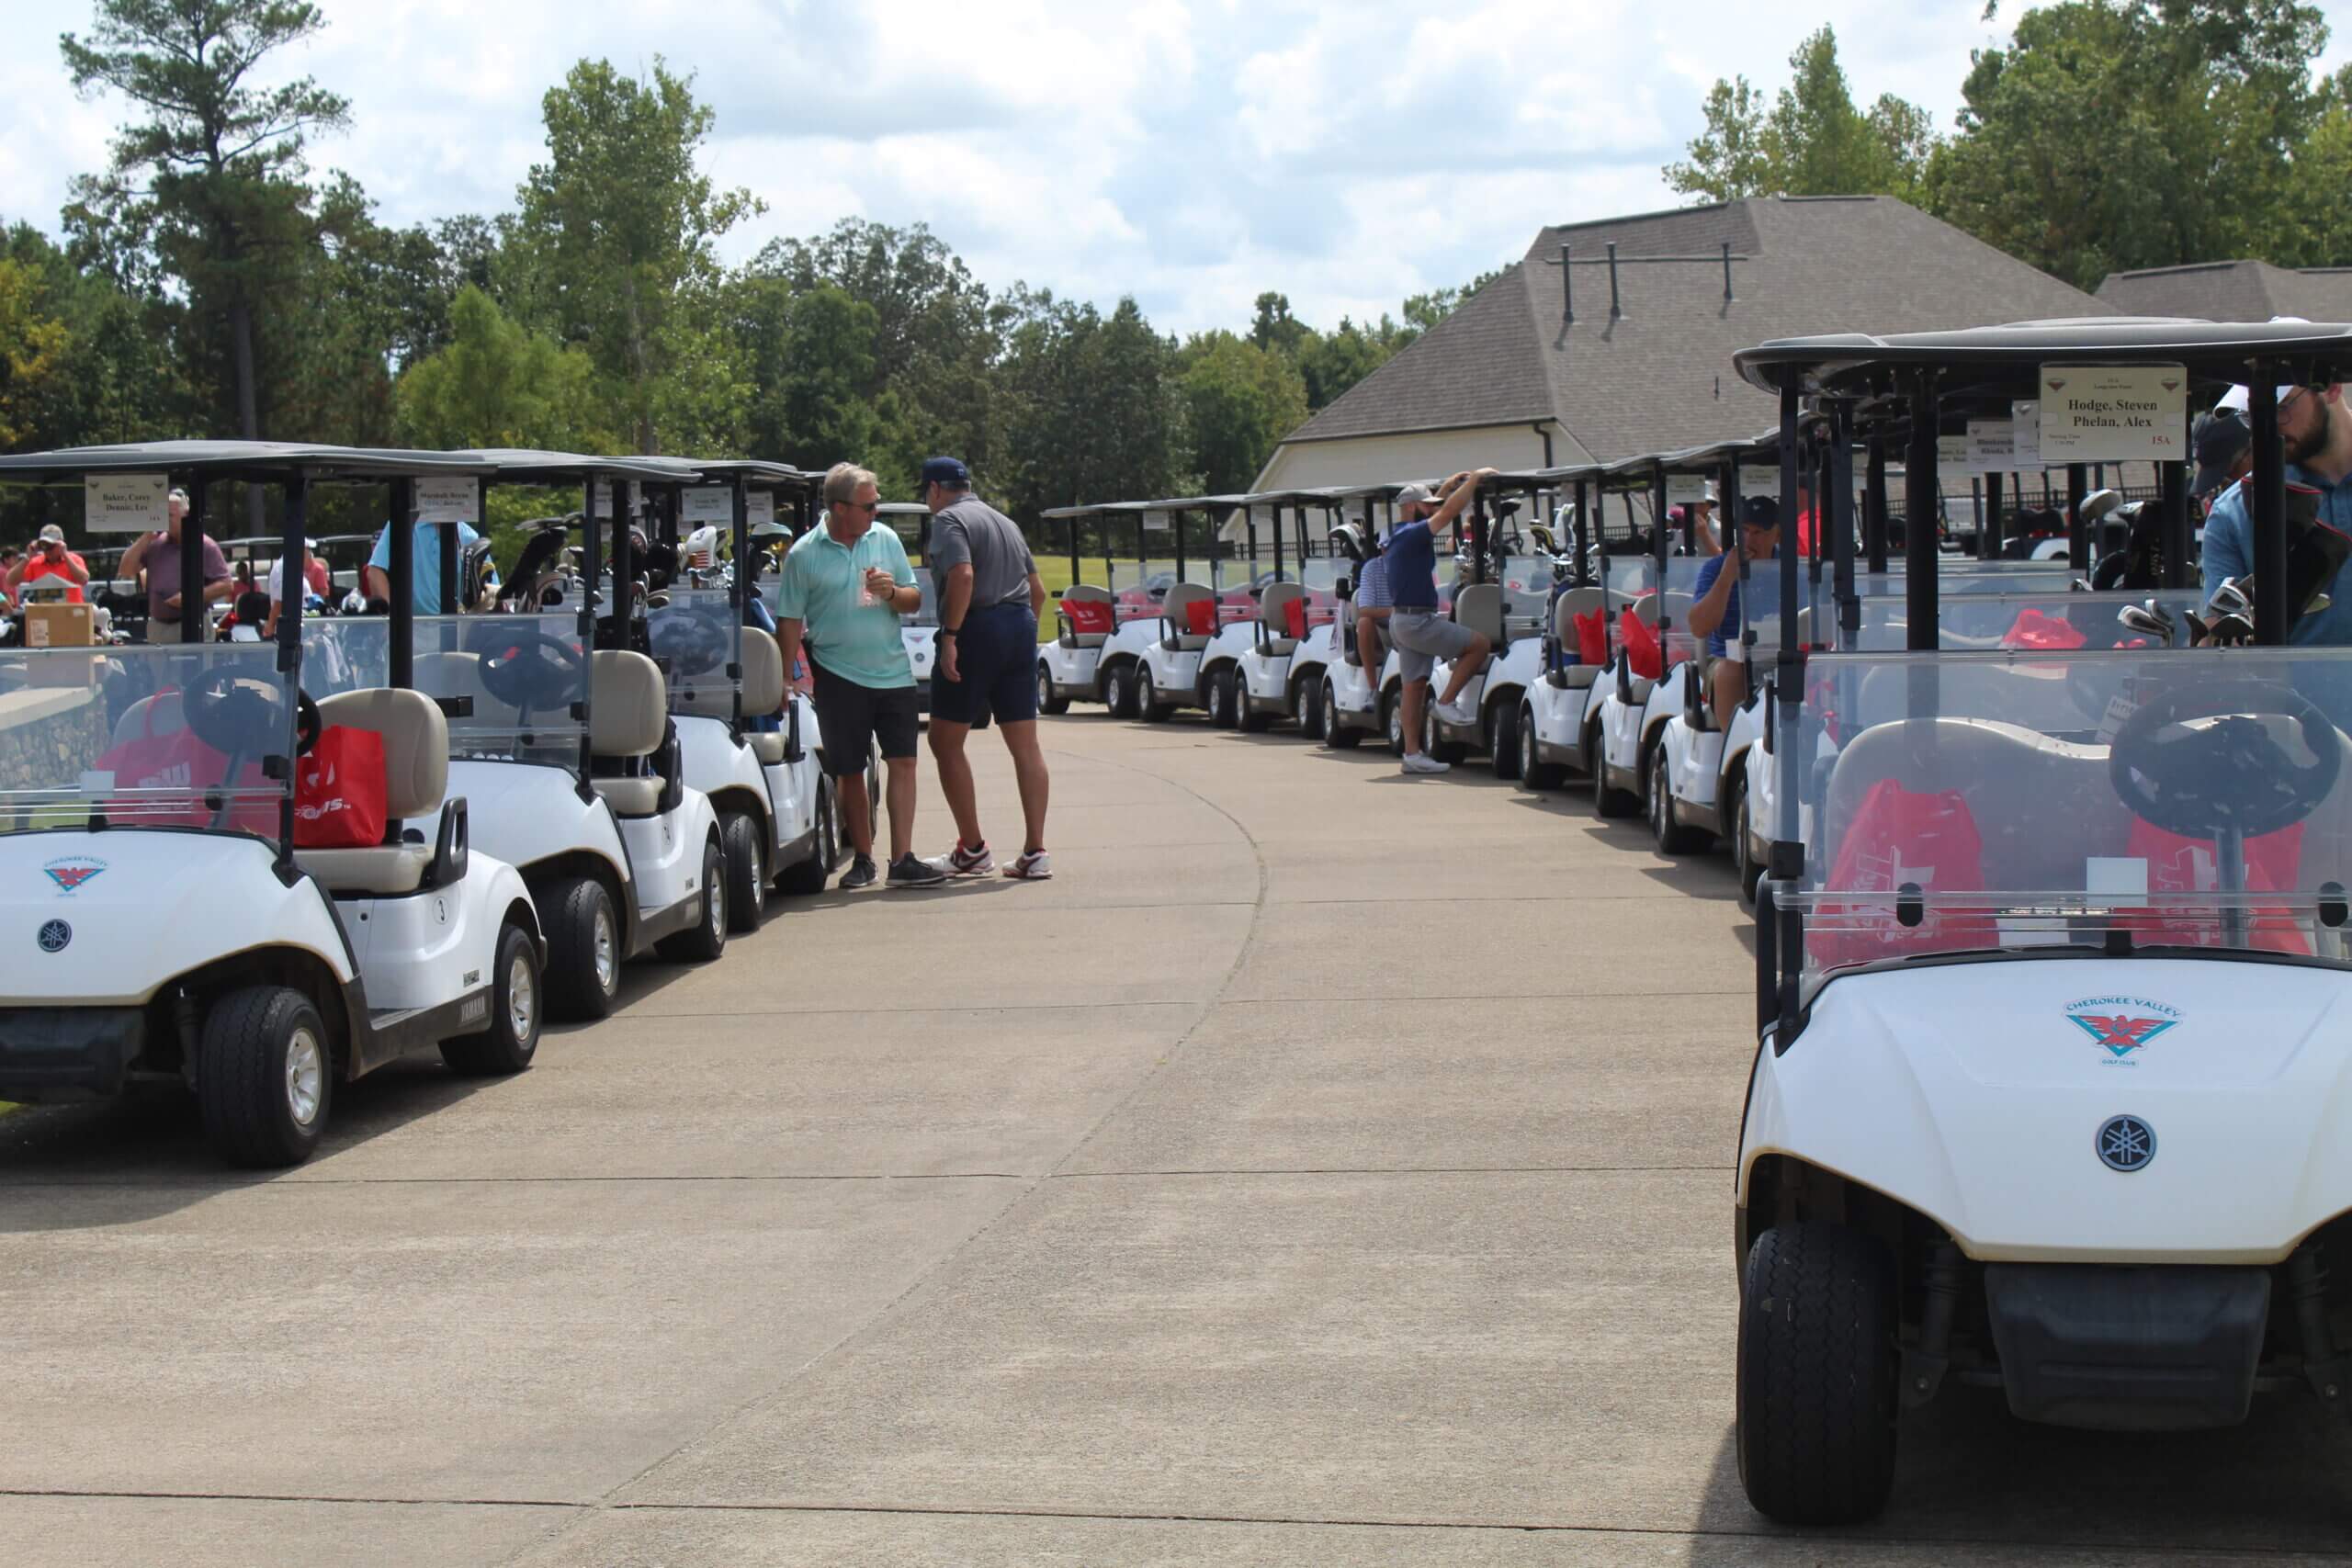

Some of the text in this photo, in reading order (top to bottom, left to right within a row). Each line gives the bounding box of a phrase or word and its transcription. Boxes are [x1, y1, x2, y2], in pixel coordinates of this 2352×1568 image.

[2068, 399, 2158, 412] Hodge, Steven
[2073, 415, 2153, 429] Phelan, Alex
[2152, 435, 2171, 446] 15A
[103, 492, 127, 502] Baker,
[438, 898, 446, 922] 3
[461, 995, 486, 1022] YAMAHA
[2066, 997, 2183, 1018] CHEROKEE VALLEY
